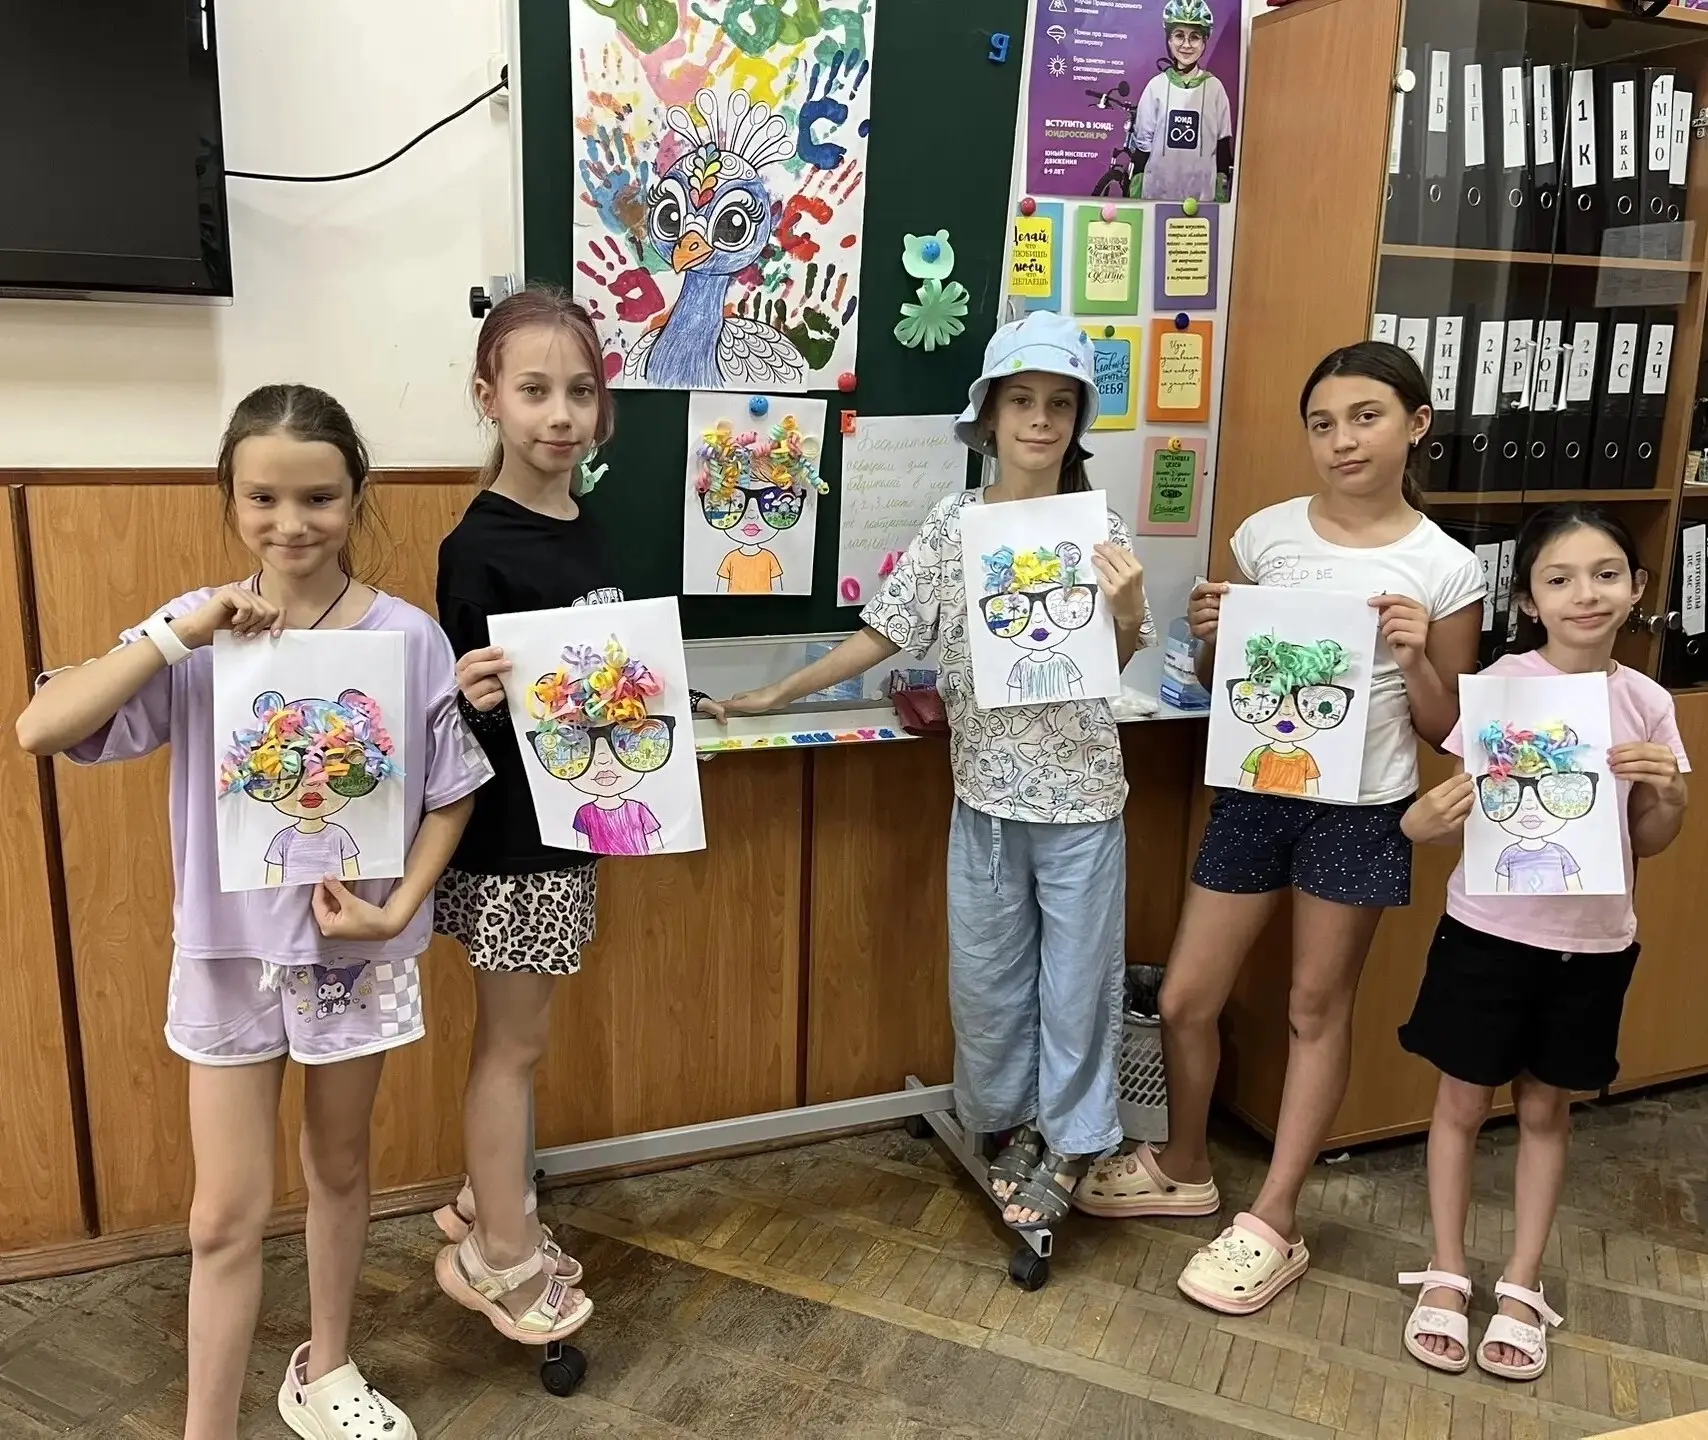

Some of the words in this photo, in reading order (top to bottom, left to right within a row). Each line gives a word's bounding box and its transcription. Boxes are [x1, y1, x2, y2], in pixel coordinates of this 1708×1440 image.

[1045, 119, 1084, 129] ВСТУПИТЬ
[1093, 122, 1114, 131] ЮИД:
[1174, 116, 1192, 124] ЮИД
[1100, 382, 1124, 394] СЕБЯ
